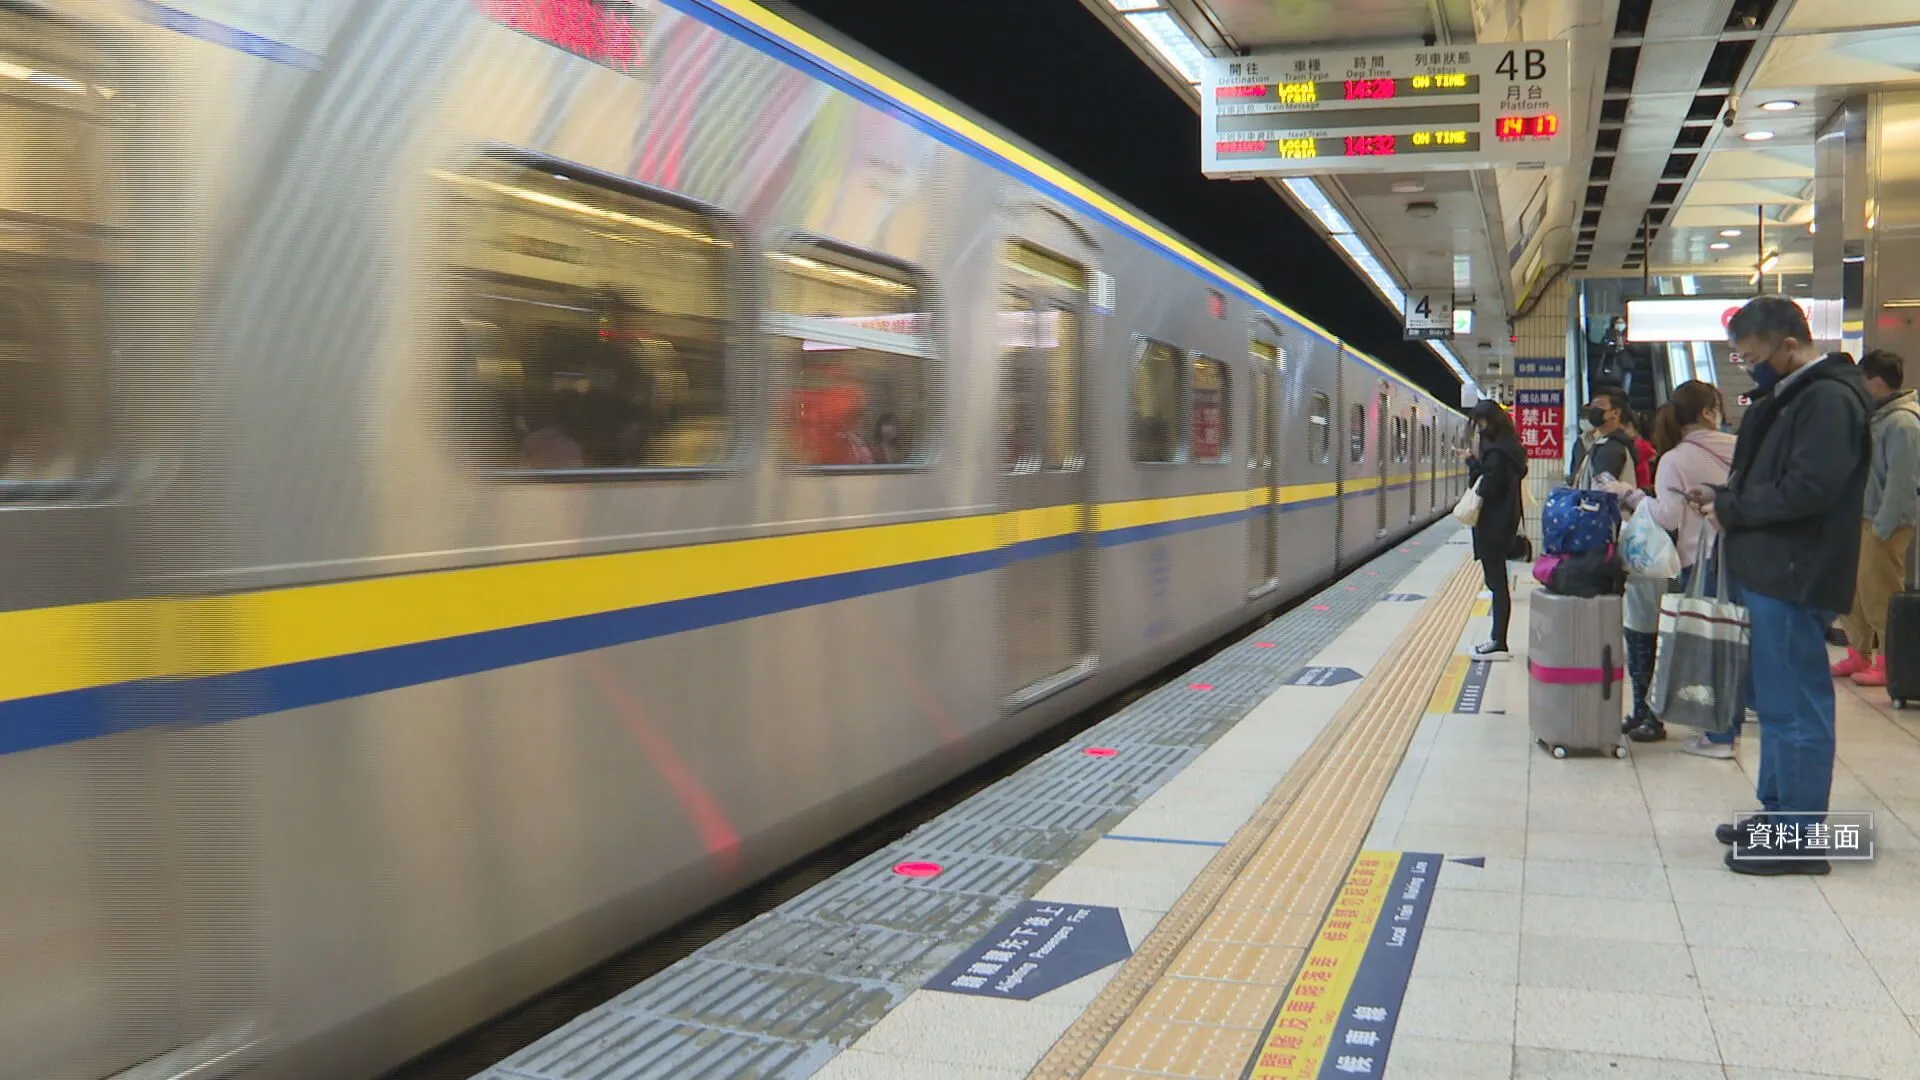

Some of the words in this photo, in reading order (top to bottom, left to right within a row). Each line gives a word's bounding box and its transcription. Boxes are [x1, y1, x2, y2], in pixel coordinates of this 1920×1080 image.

[1229, 62, 1259, 76] 開往
[1294, 58, 1320, 72] 車種
[1354, 55, 1384, 68] 時間
[1495, 49, 1547, 81] 4B
[1218, 76, 1270, 85] Destination
[1279, 80, 1315, 96] Local
[1412, 75, 1430, 89] ON
[1434, 73, 1466, 87] TIME
[1280, 93, 1316, 104] Train
[1506, 84, 1542, 100] 月台
[1500, 101, 1550, 110] Platform
[1279, 137, 1315, 153] Local
[1412, 131, 1430, 145] ON
[1434, 130, 1466, 144] TIME
[1280, 149, 1316, 160] Train
[1415, 295, 1431, 319] 4
[1522, 408, 1558, 426] 禁止
[1521, 428, 1557, 446] 進入
[1535, 447, 1558, 457] Entry
[1394, 904, 1414, 921] Train
[1385, 926, 1407, 947] Local
